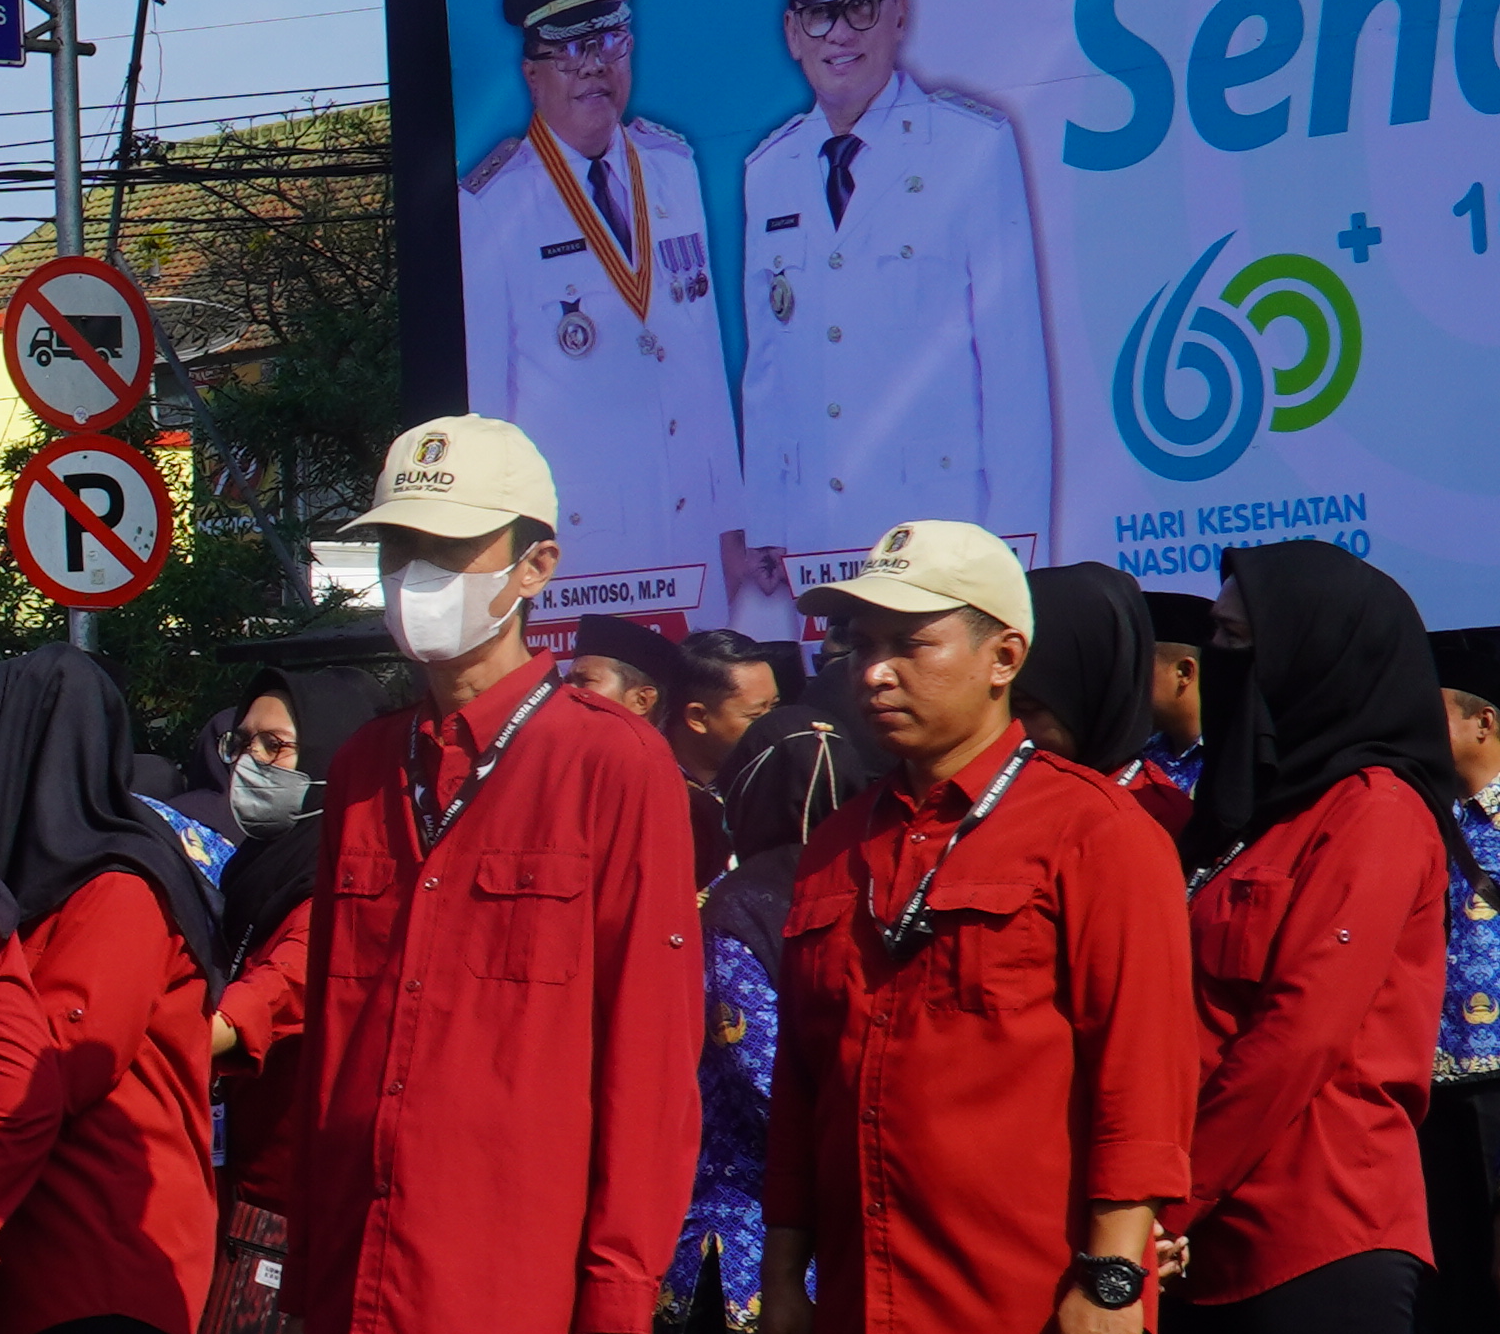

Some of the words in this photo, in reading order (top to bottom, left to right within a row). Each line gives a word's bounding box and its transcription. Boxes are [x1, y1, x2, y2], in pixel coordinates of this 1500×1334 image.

[395, 471, 455, 485] BUMD
[63, 473, 125, 572] P
[1115, 510, 1184, 543] HARI
[1198, 492, 1367, 536] KESEHATAN
[542, 590, 557, 609] H.
[561, 581, 634, 608] SANTOSO,
[638, 578, 676, 601] M.Pd
[820, 563, 836, 583] H.
[494, 723, 515, 749] BANK
[511, 703, 532, 726] KOTA
[528, 682, 553, 706] BLITAR
